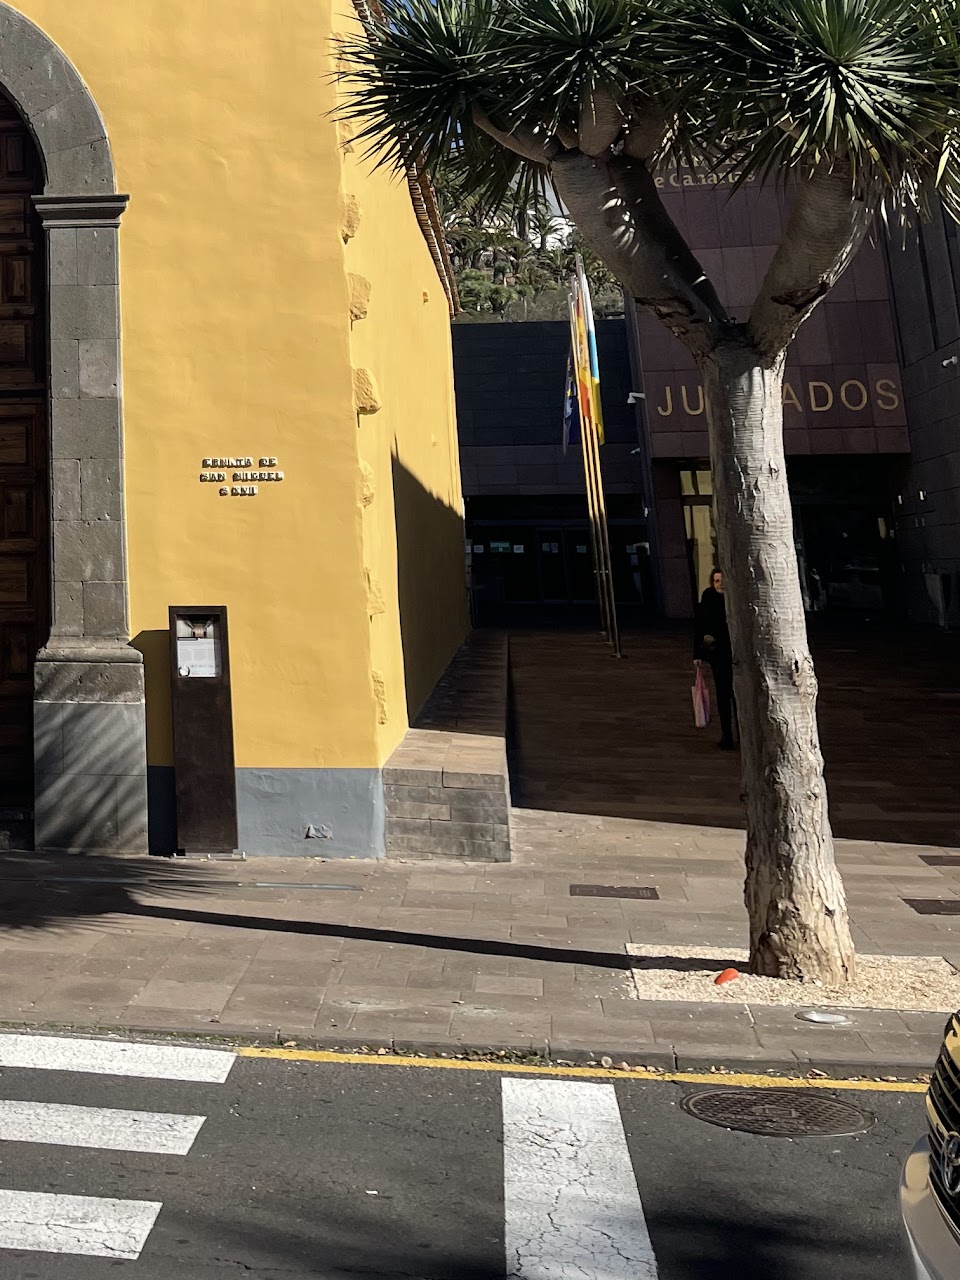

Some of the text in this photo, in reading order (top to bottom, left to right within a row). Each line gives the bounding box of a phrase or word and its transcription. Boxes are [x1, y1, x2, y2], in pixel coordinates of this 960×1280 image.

[657, 378, 900, 417] JUADOS
[202, 456, 277, 468] ERMITA DE
[199, 471, 284, 482] SAN MIGUEL
